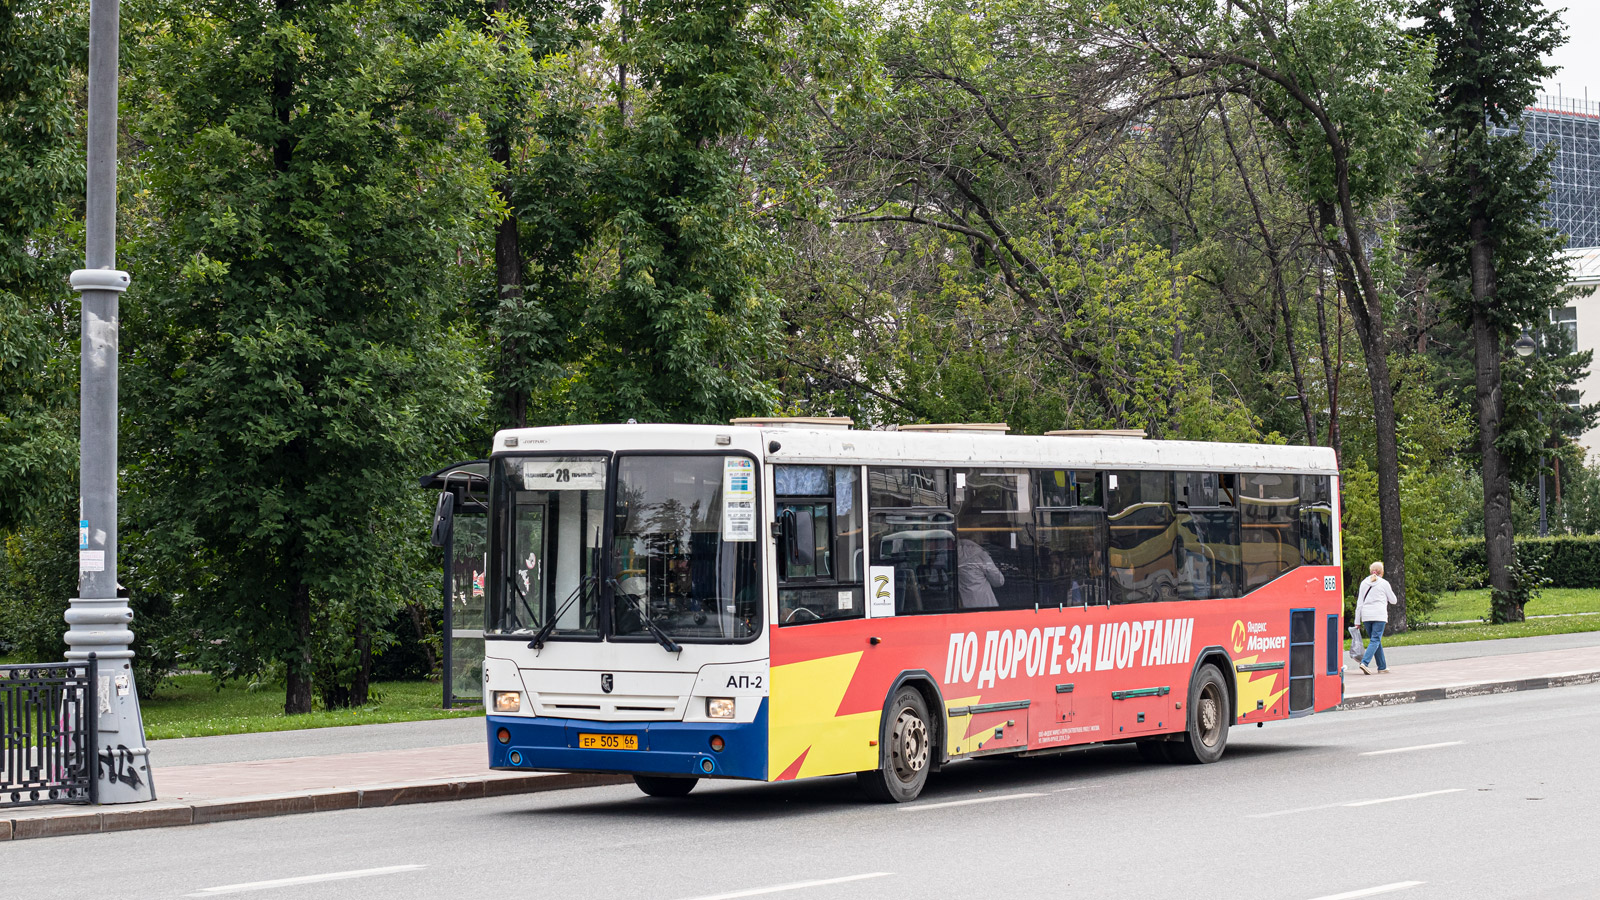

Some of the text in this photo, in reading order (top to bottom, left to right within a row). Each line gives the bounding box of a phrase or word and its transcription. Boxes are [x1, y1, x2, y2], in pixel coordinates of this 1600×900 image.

[555, 468, 570, 483] 28
[1325, 577, 1336, 590] 866
[1247, 621, 1267, 634] Яндекс
[1247, 636, 1287, 653] Маркет
[944, 617, 1194, 689] ПО ДОРОГЕ ЗА ШОРТАМИ
[726, 675, 762, 688] АП-2
[600, 736, 619, 748] 505
[624, 735, 635, 745] 66
